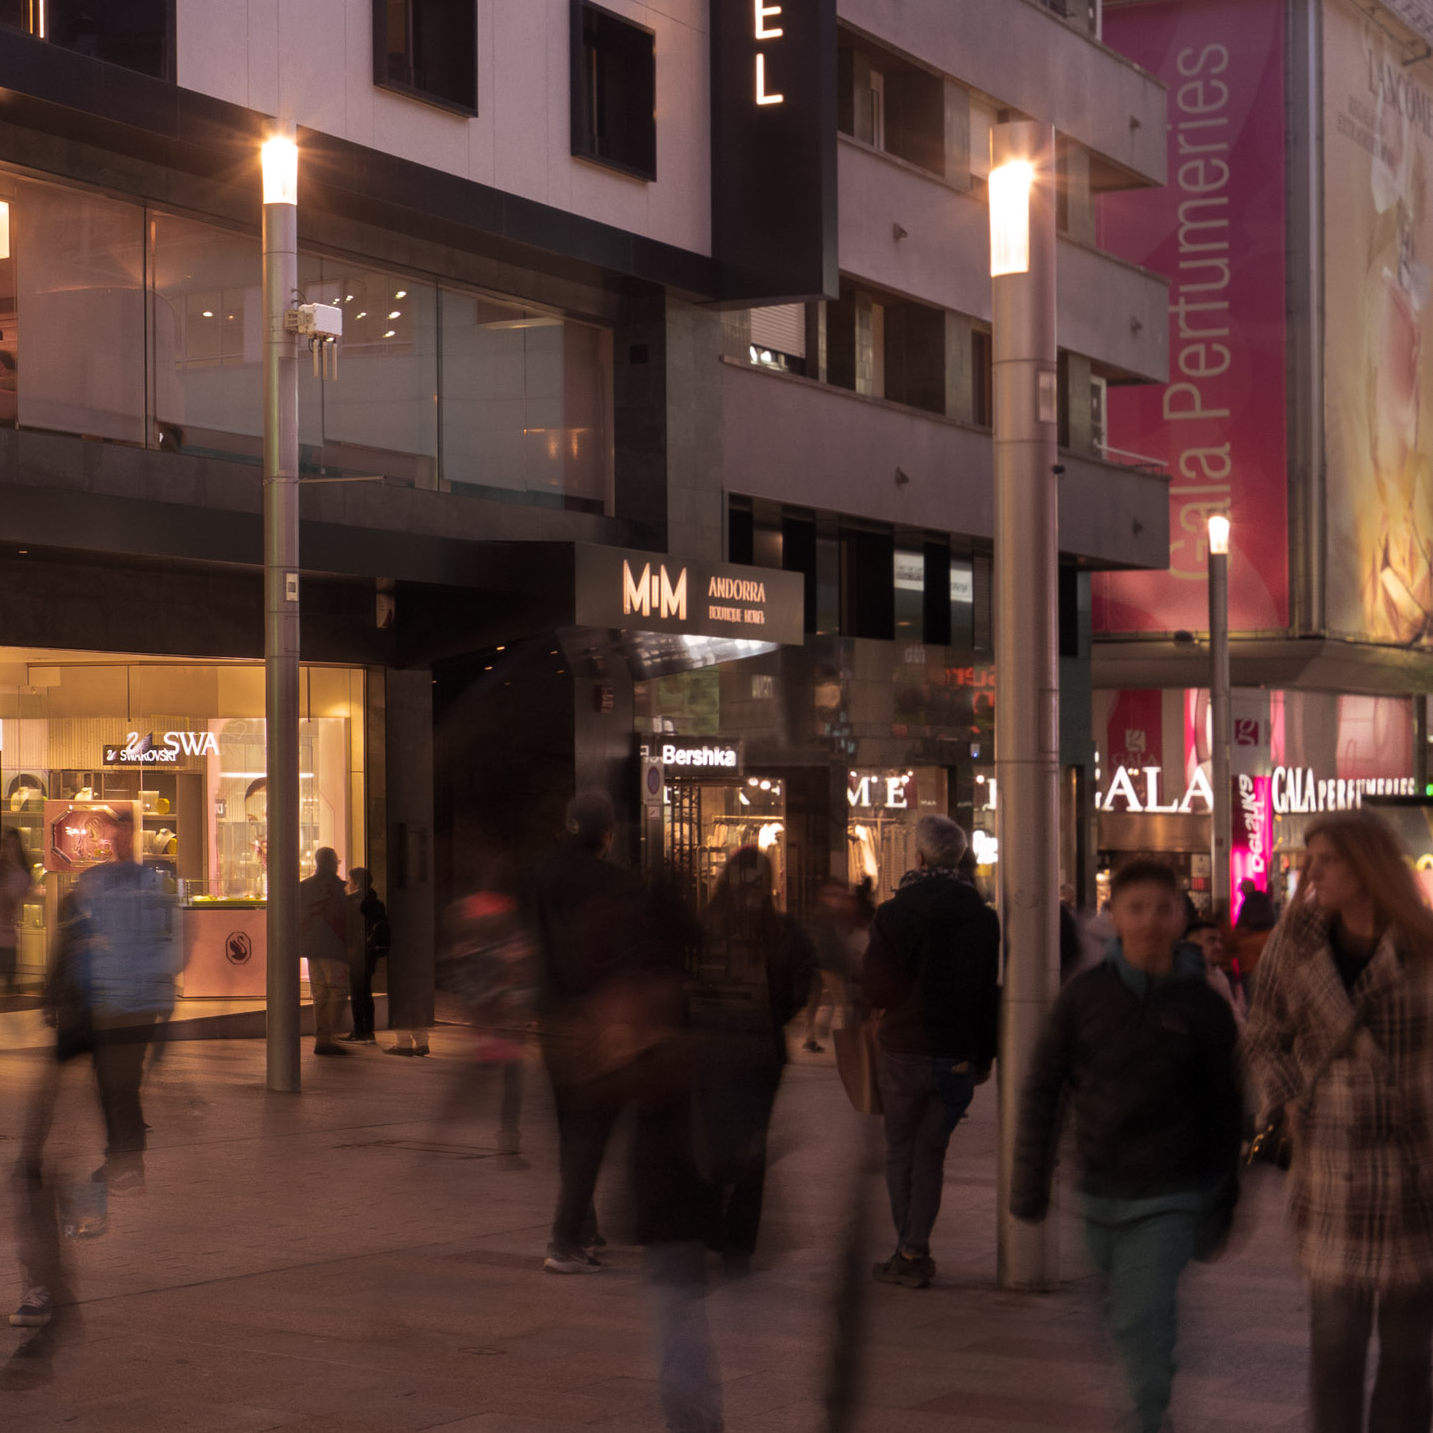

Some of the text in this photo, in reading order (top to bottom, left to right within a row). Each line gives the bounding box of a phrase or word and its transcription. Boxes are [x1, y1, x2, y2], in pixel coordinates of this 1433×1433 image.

[1162, 42, 1232, 421] Perfumeries
[623, 558, 688, 621] MIM
[708, 575, 767, 604] ANDORRA
[708, 604, 743, 623] BOUTIQUE
[119, 747, 178, 762] SWAROVSKI
[662, 745, 737, 767] Bershka
[1271, 766, 1317, 814] GALA
